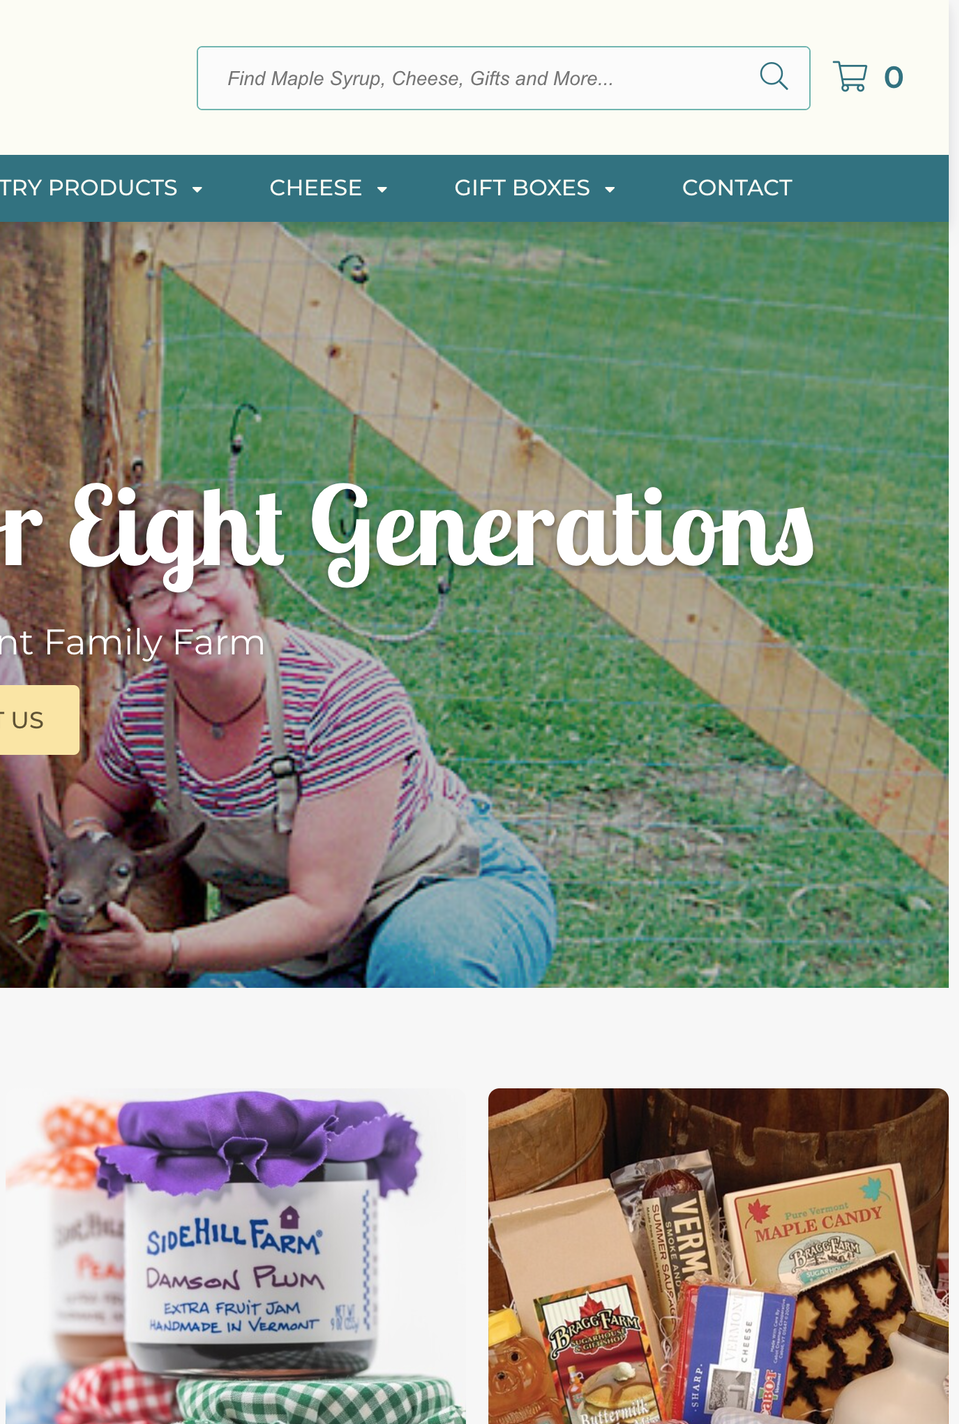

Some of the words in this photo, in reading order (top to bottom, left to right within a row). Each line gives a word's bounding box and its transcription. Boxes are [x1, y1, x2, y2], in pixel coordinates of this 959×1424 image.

[227, 70, 267, 86] Find
[271, 70, 324, 90] Maple
[330, 70, 385, 90] Syrup,
[392, 70, 463, 89] Cheese,
[470, 70, 510, 86] Gifts
[515, 70, 549, 86] and
[553, 70, 613, 86] More...
[884, 65, 904, 89] 0
[49, 178, 178, 197] PRODUCTS
[269, 178, 363, 197] CHEESE
[454, 178, 507, 197] GIFT
[513, 178, 591, 197] BOXES
[682, 178, 794, 197] CONTACT
[784, 1210, 808, 1221] Pure
[809, 1202, 849, 1214] Vermont
[652, 1204, 666, 1260] SUMMER
[755, 1218, 818, 1243] MAPLE
[822, 1205, 883, 1229] CANDY
[147, 1217, 246, 1255] SIDEHILL
[790, 1240, 831, 1274] BRAGG
[830, 1235, 861, 1254] FARM
[147, 1267, 240, 1290] DAMSON
[254, 1265, 325, 1290] PLUM
[164, 1302, 209, 1315] EXTRA
[266, 1301, 300, 1315] JAM
[150, 1319, 222, 1333] HANDMADE
[227, 1319, 242, 1332] IN
[248, 1317, 320, 1332] VERMONT
[549, 1316, 599, 1359] BRAGG
[597, 1309, 641, 1331] FARM
[571, 1328, 627, 1346] SUGARHOUSE
[741, 1321, 752, 1363] CHEESE
[692, 1367, 703, 1407] SHARP
